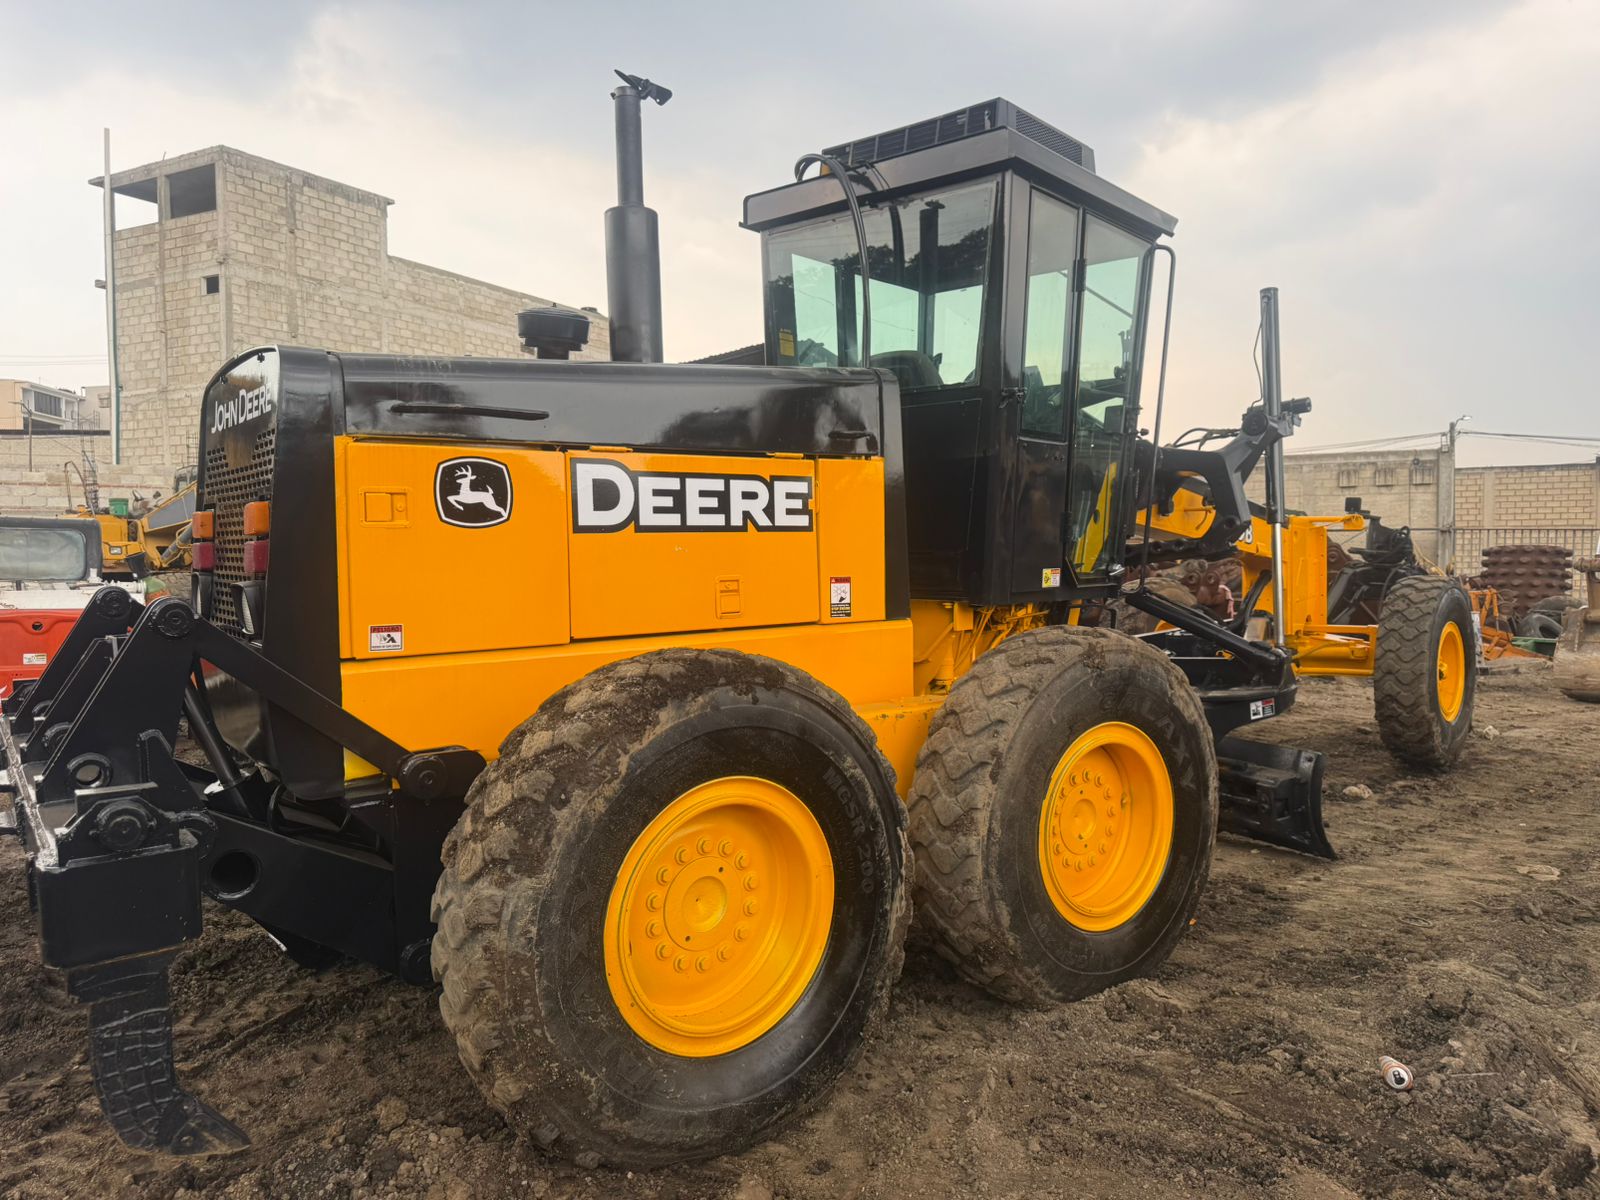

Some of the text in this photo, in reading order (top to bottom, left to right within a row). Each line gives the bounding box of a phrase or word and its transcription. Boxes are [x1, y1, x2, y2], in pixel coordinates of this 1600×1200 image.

[211, 383, 272, 434] JOHN DEERE
[574, 461, 811, 529] DEERE
[858, 843, 874, 894] 200
